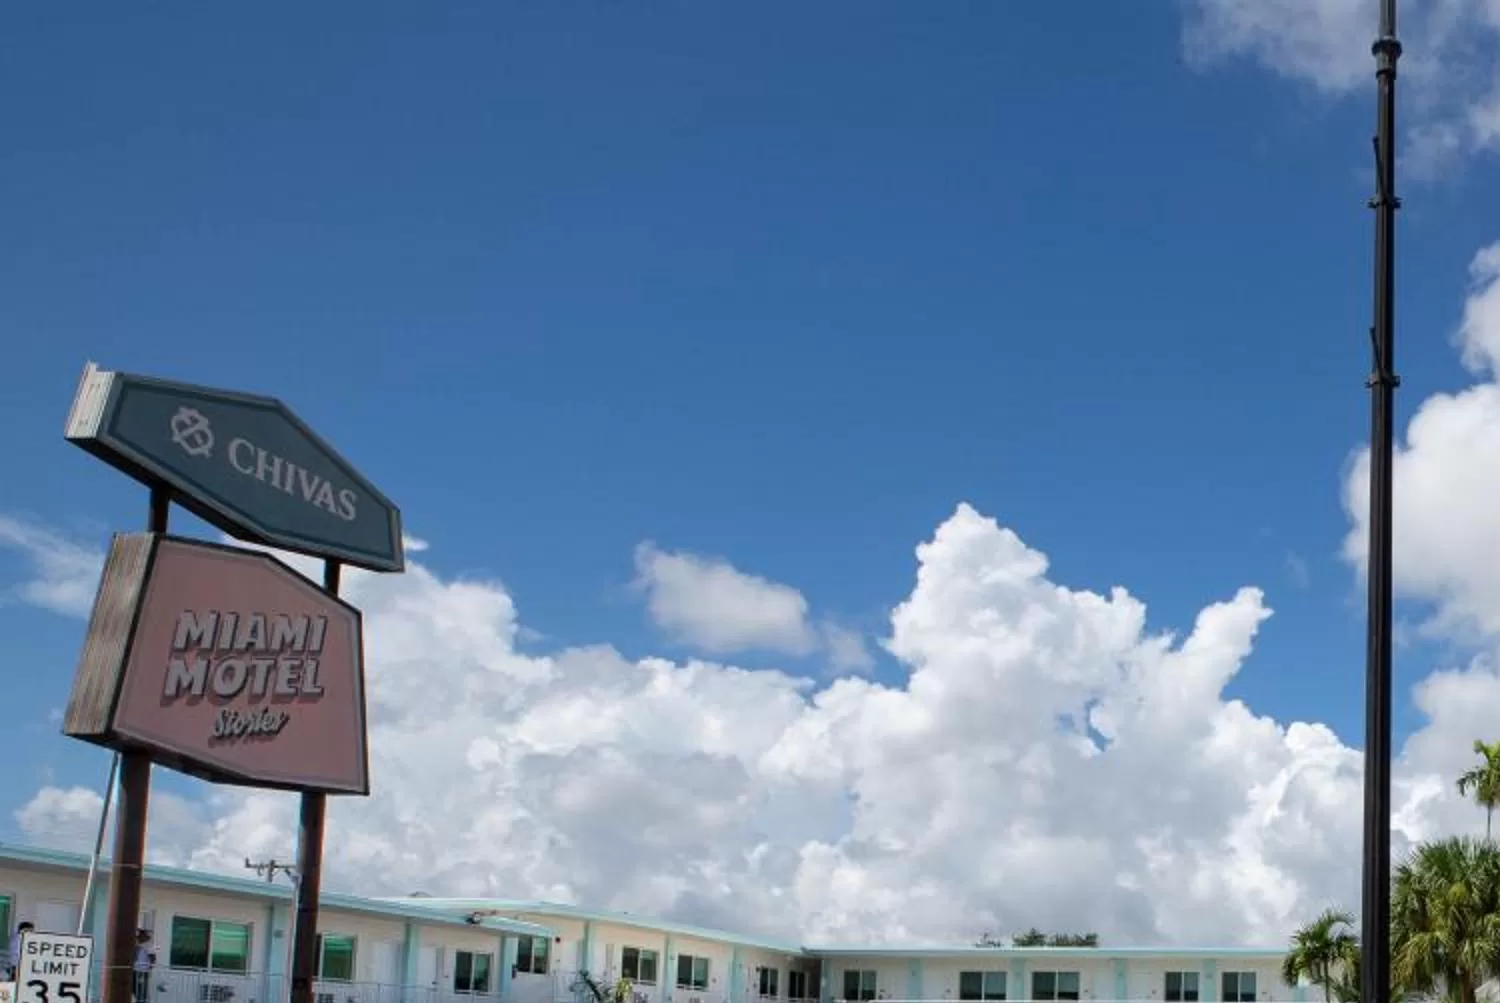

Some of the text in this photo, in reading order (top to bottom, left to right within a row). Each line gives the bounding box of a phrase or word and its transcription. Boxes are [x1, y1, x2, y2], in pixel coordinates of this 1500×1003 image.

[228, 438, 357, 520] CHIVAS
[172, 611, 328, 654] MIAMI
[163, 656, 325, 701] MOTEL
[27, 941, 88, 959] SPEED
[31, 960, 80, 976] LIMIT
